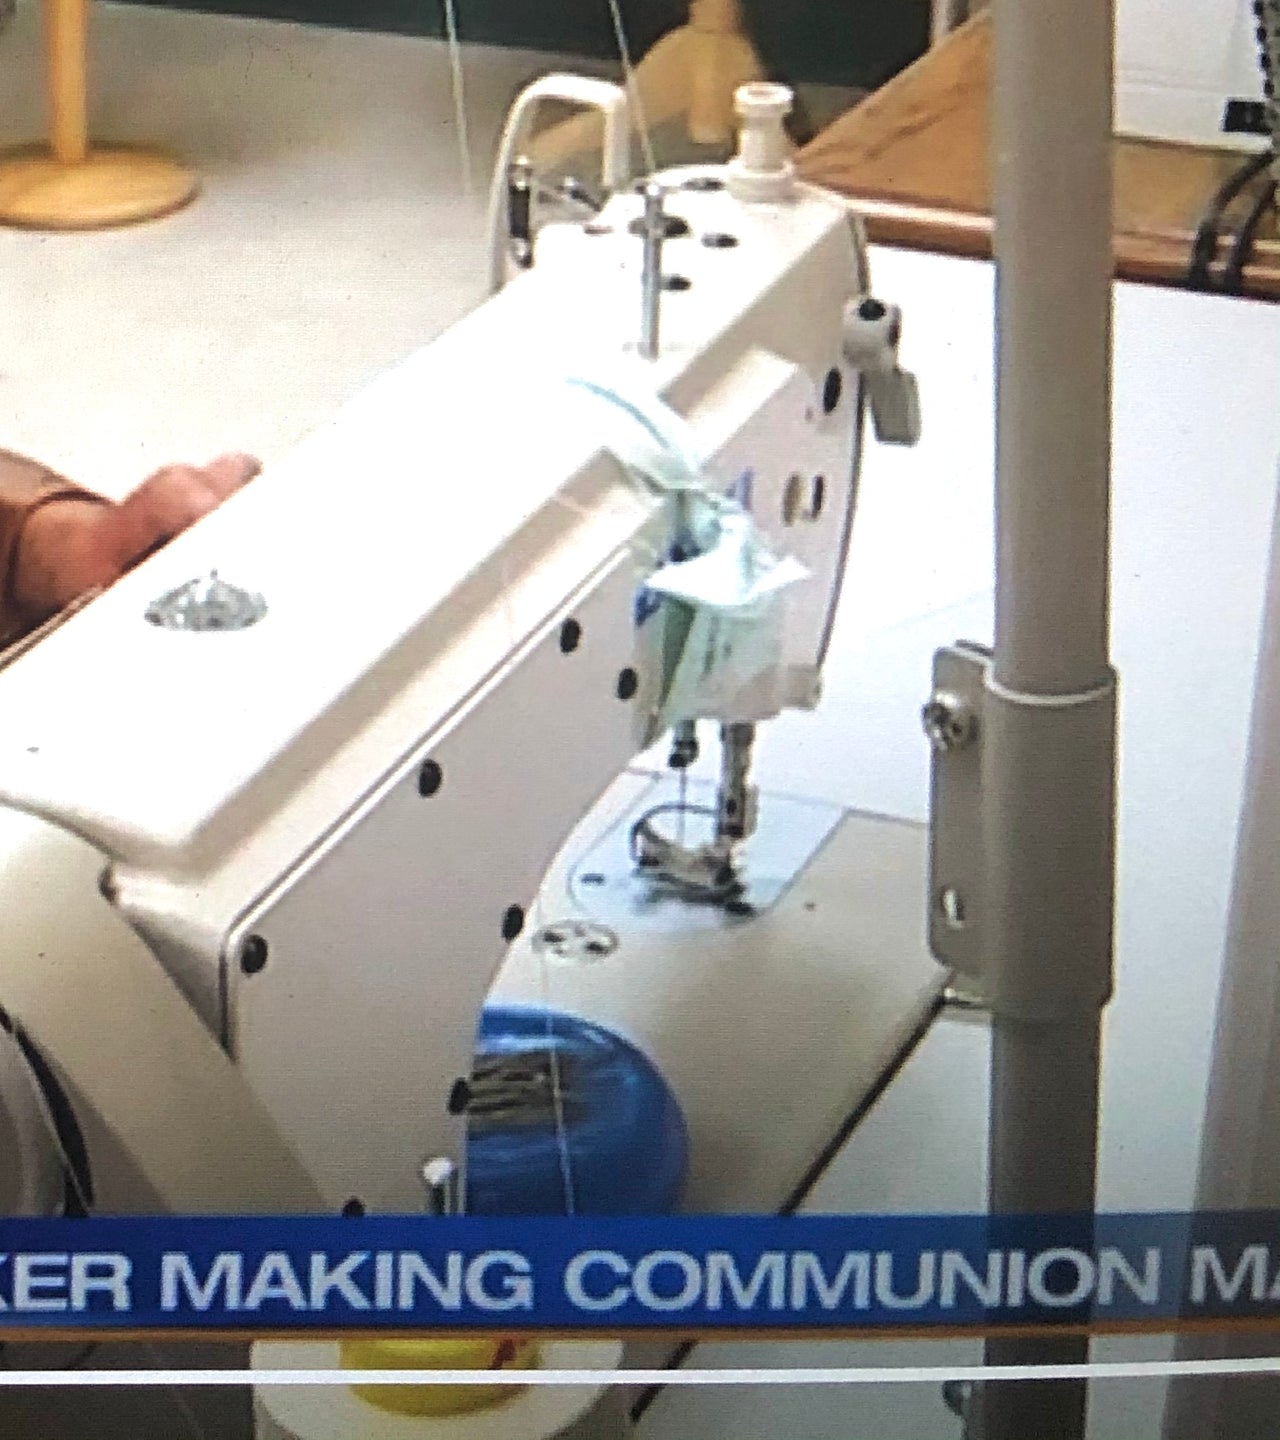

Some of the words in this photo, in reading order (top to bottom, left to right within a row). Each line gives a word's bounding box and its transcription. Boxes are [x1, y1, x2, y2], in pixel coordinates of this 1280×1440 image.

[159, 1251, 533, 1312] MAKING
[565, 1247, 1162, 1311] COMMUNION
[1191, 1245, 1280, 1303] M
